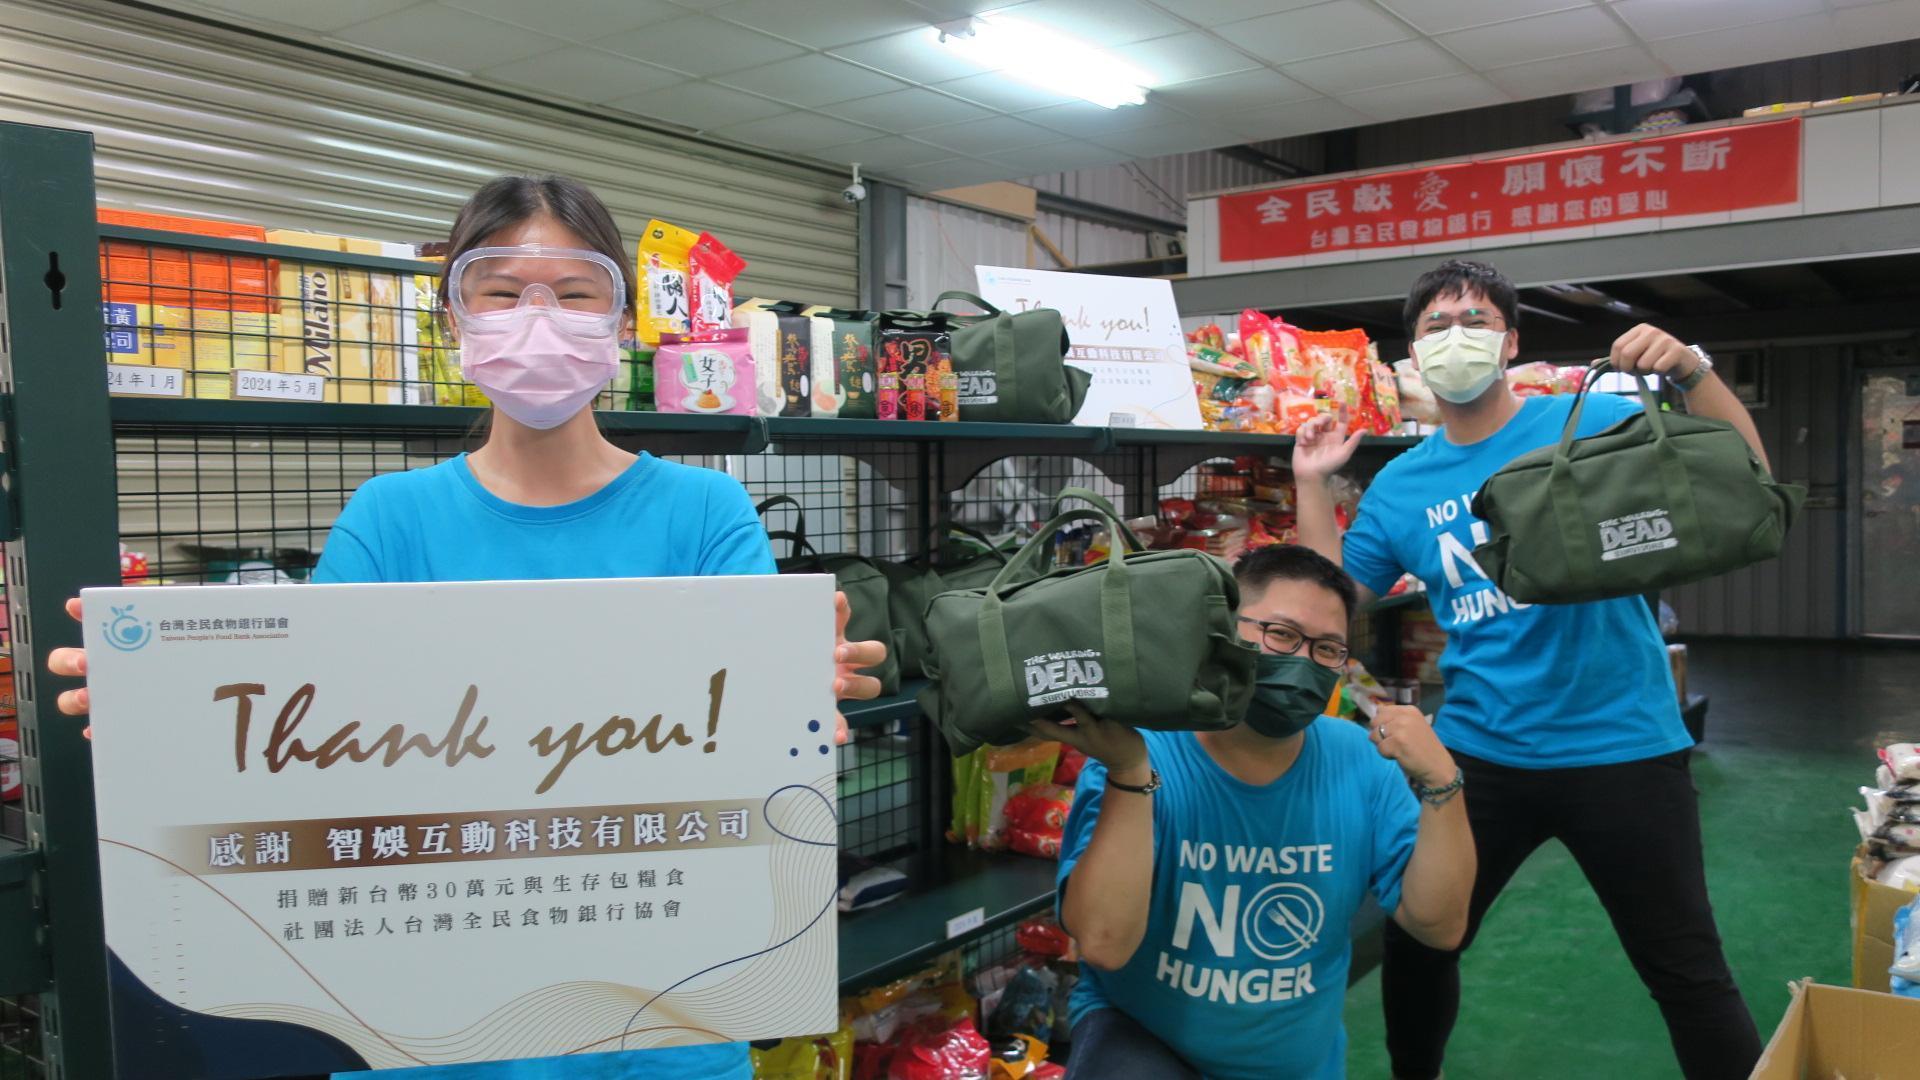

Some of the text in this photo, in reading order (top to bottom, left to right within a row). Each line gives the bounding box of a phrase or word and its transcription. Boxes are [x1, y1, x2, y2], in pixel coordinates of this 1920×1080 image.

[1311, 190, 1668, 248] 台灣全民食物銀行 感謝您的愛心
[304, 271, 332, 378] Milano
[1015, 298, 1151, 341] Tnk you!
[699, 356, 716, 388] 女子
[958, 377, 997, 395] EAD
[1426, 499, 1459, 528] NO
[1600, 517, 1674, 551] DEAD
[1437, 522, 1489, 589] N
[159, 617, 289, 631] 台灣全民食物銀行協會
[1452, 588, 1532, 625] HUN
[1024, 655, 1047, 666] THE
[1025, 660, 1103, 695] DEAD
[213, 668, 727, 794] Thank you!
[209, 808, 752, 868] 感謝 智娛互動科技有限公司
[1180, 840, 1333, 874] NO WASTE
[277, 867, 685, 909] 捐贈新台幣30萬元與生存包糧食
[283, 899, 682, 942] 社團法人台灣全民食物銀行協會
[1156, 951, 1316, 1004] HUNGER
